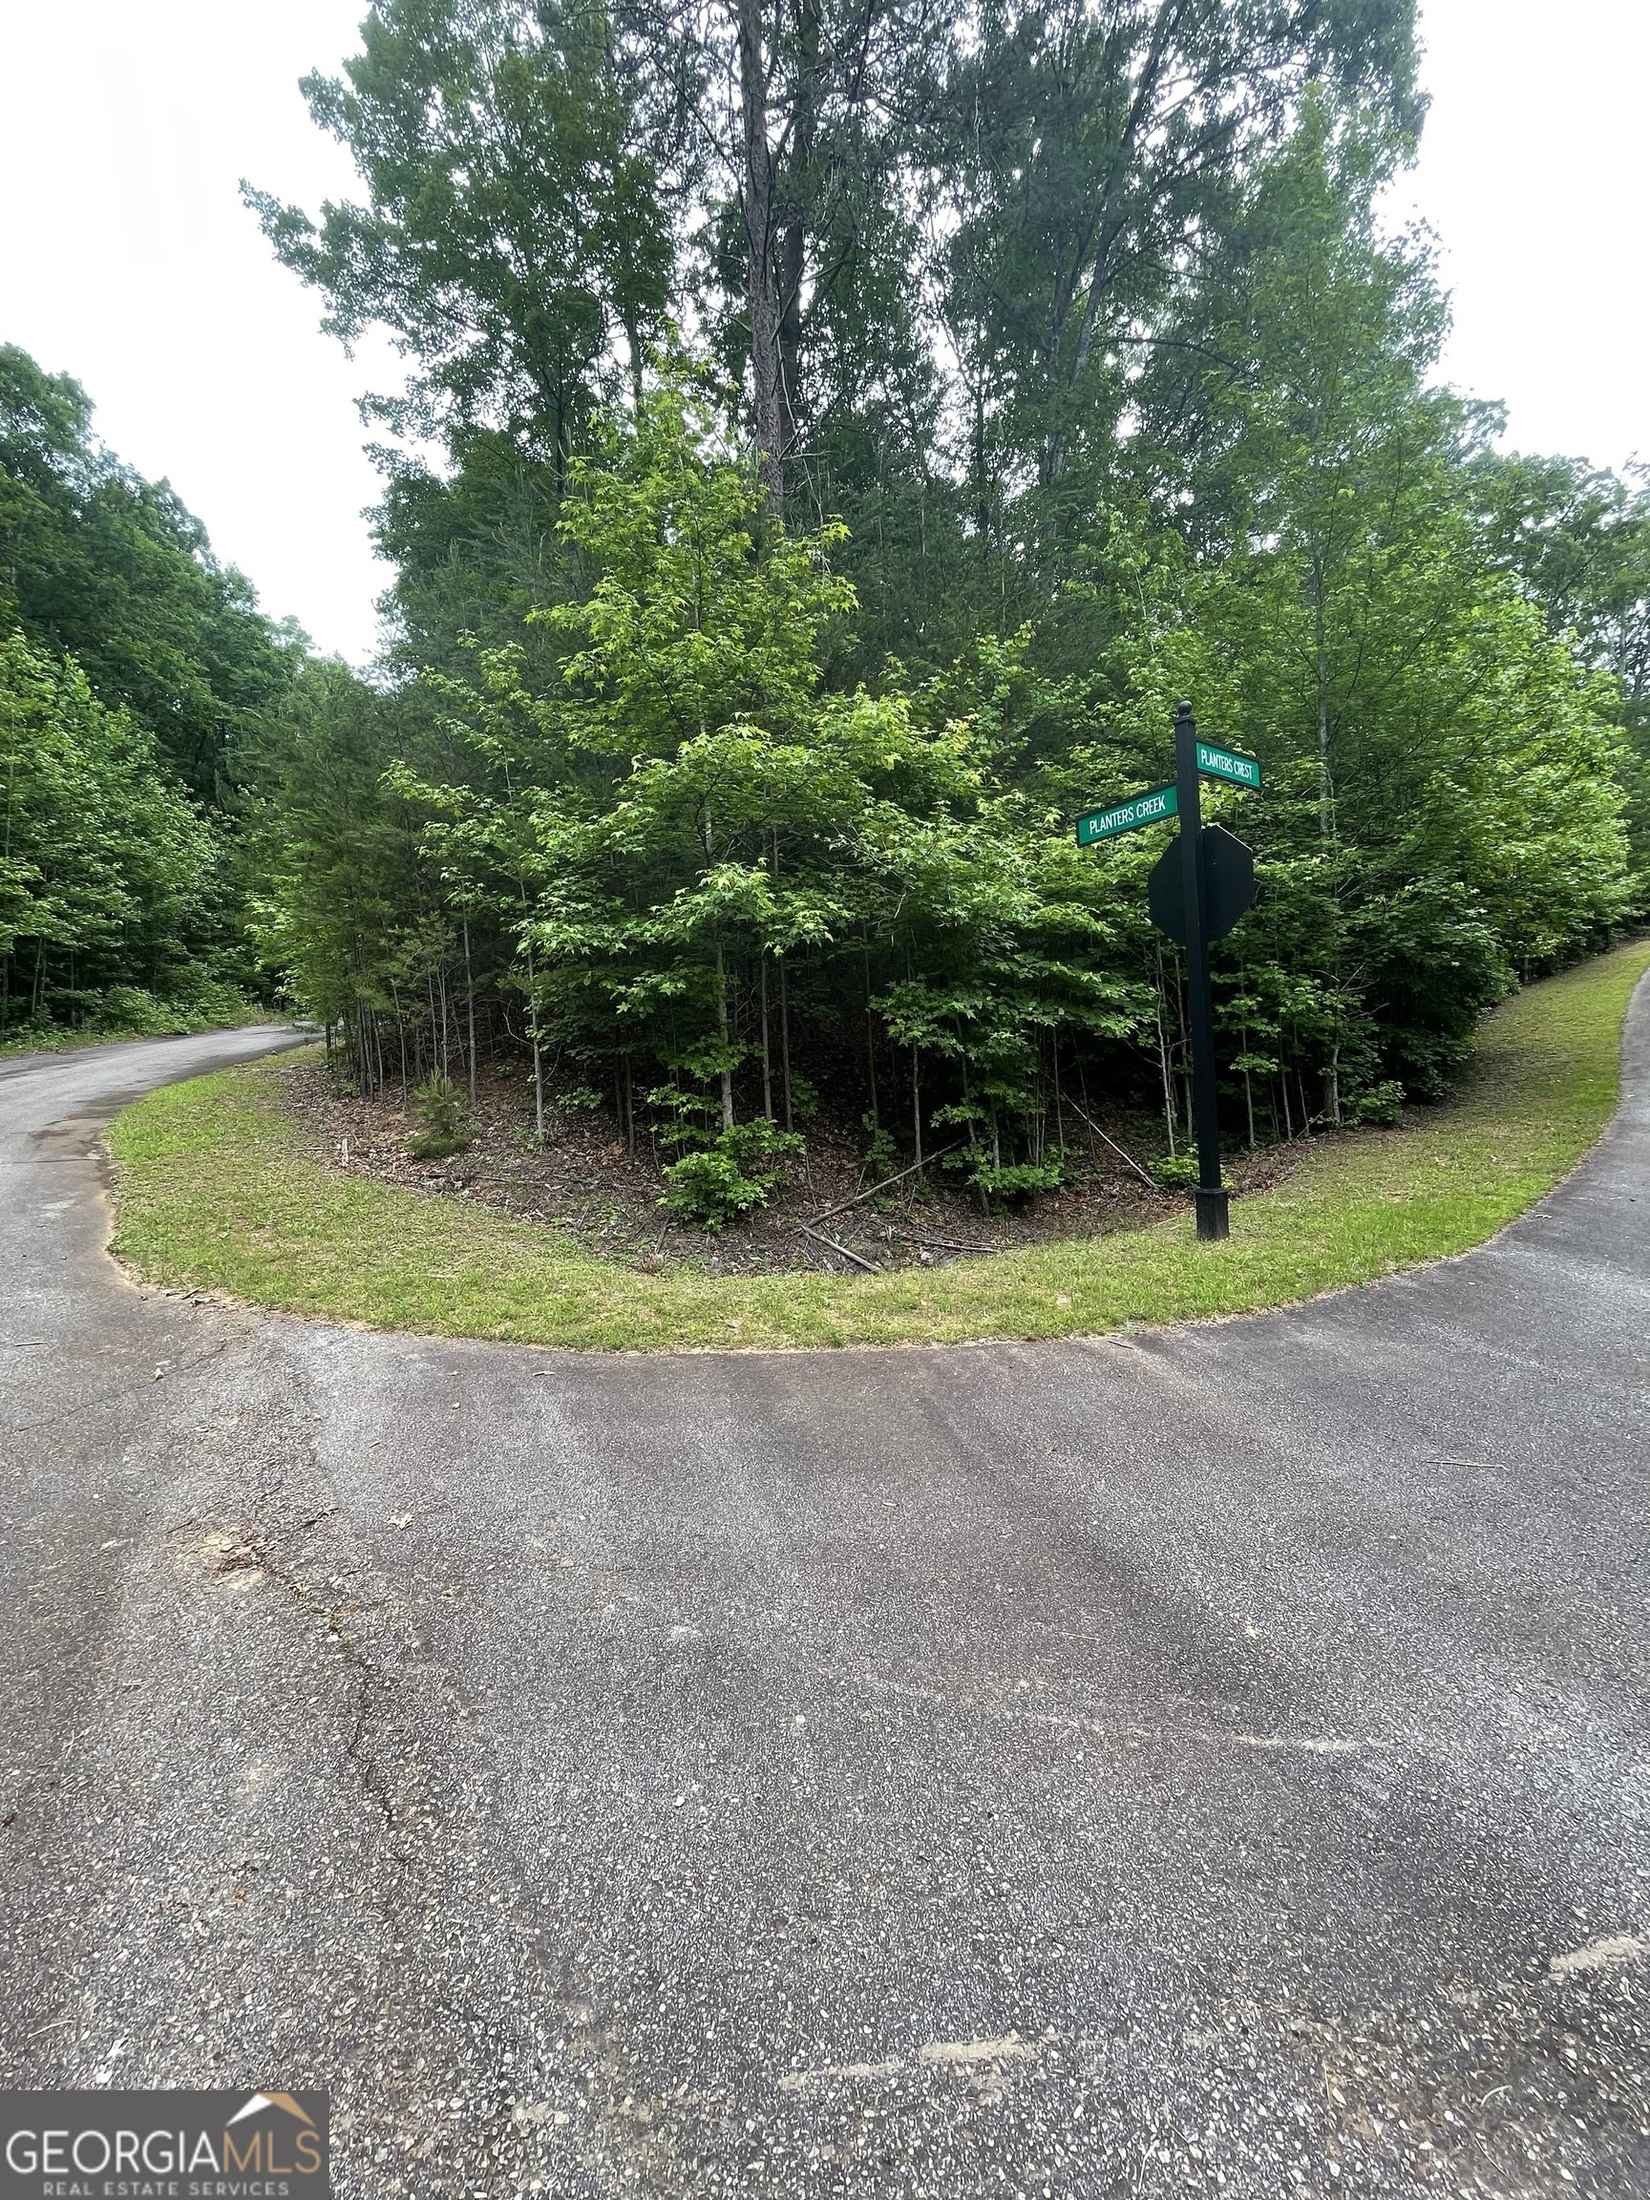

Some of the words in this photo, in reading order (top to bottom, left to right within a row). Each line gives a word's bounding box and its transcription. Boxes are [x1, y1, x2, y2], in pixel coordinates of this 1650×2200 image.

[1201, 750, 1233, 773] PLANTERS
[1233, 762, 1252, 779] CREST
[1089, 806, 1134, 835] PLANTERS
[1136, 795, 1166, 818] CREEK
